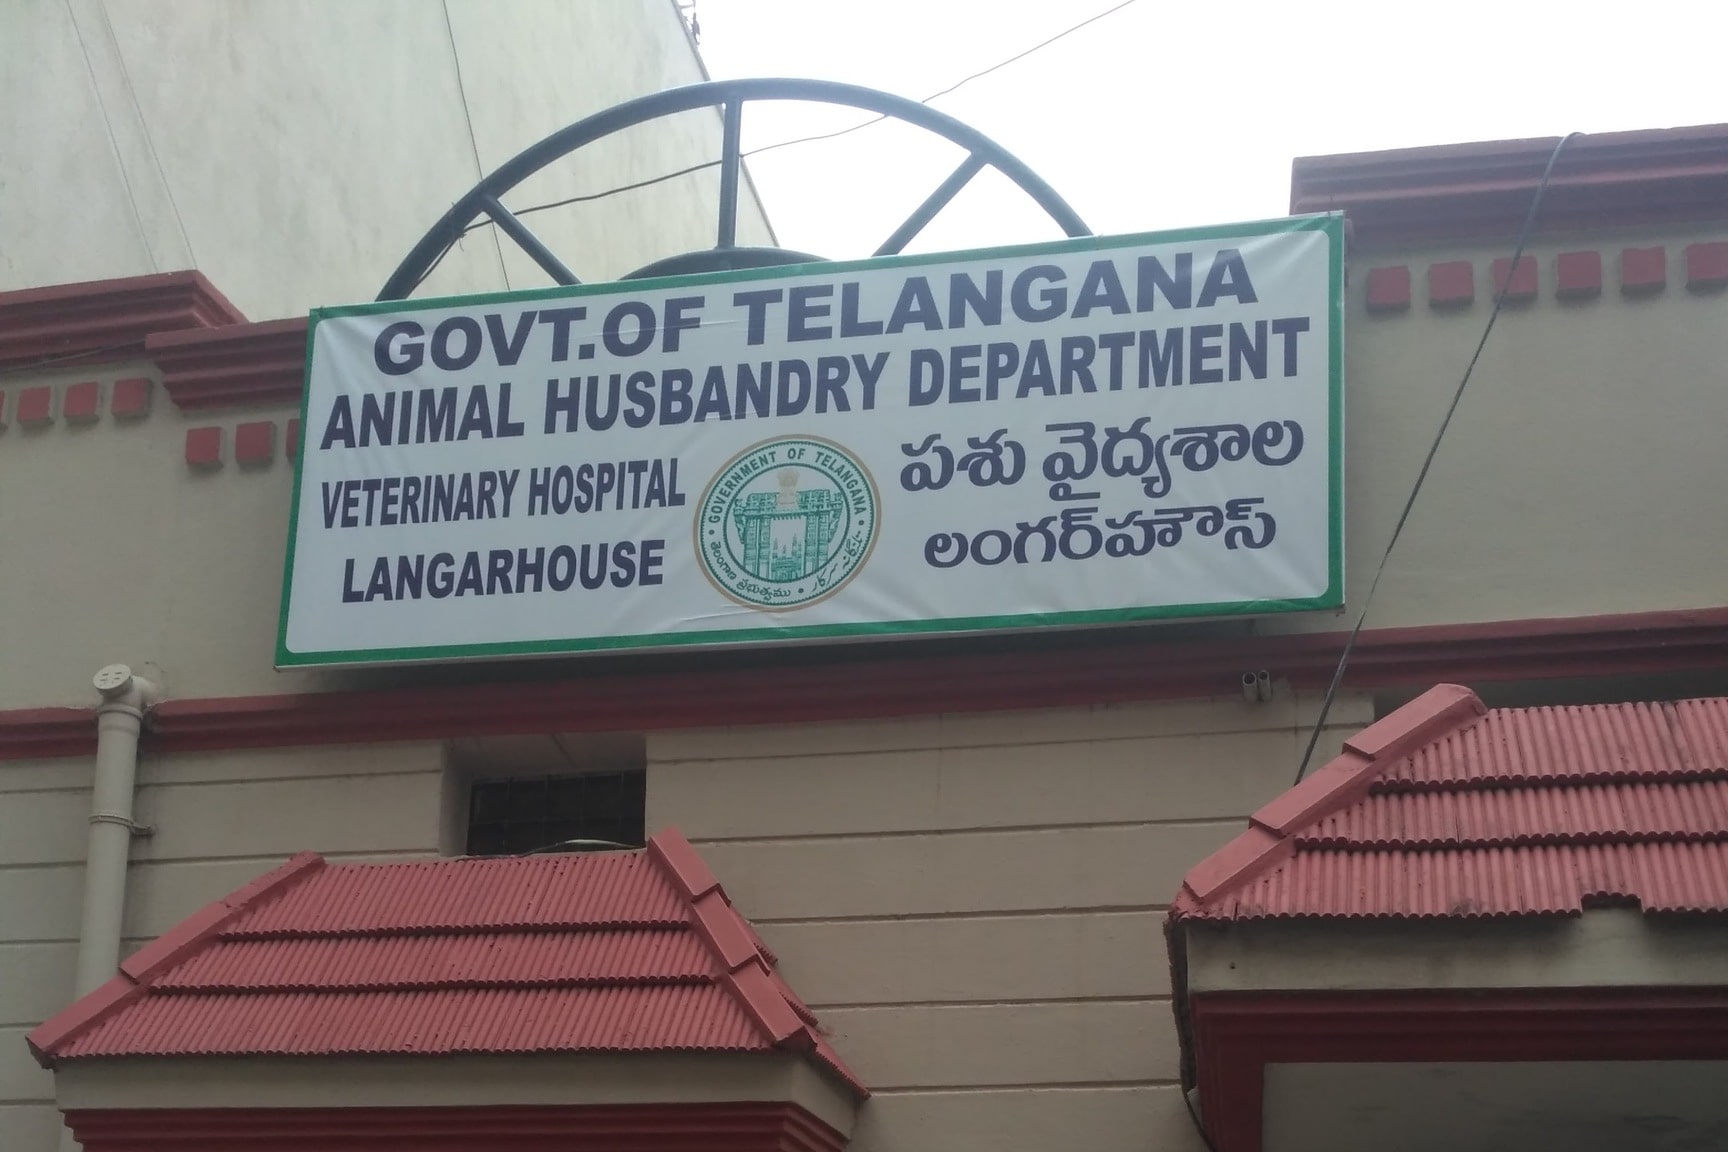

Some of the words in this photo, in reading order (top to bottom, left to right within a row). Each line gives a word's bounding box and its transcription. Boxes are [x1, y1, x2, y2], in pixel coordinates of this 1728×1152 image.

[733, 248, 1259, 346] TELANGANA
[319, 383, 524, 450] ANIMAL
[543, 352, 890, 434] HUSBANDRY
[908, 316, 1310, 407] DEPARTMENT
[321, 469, 520, 529] VETERINARY
[527, 458, 686, 516] HOSPITAL
[708, 450, 777, 524] GOVERNMENT
[787, 448, 806, 460] OF
[815, 451, 867, 515] TELANGANA
[899, 429, 1027, 492] పశు
[1042, 417, 1304, 502] వైద్యశాల
[342, 539, 665, 602] LANGARHOUSE
